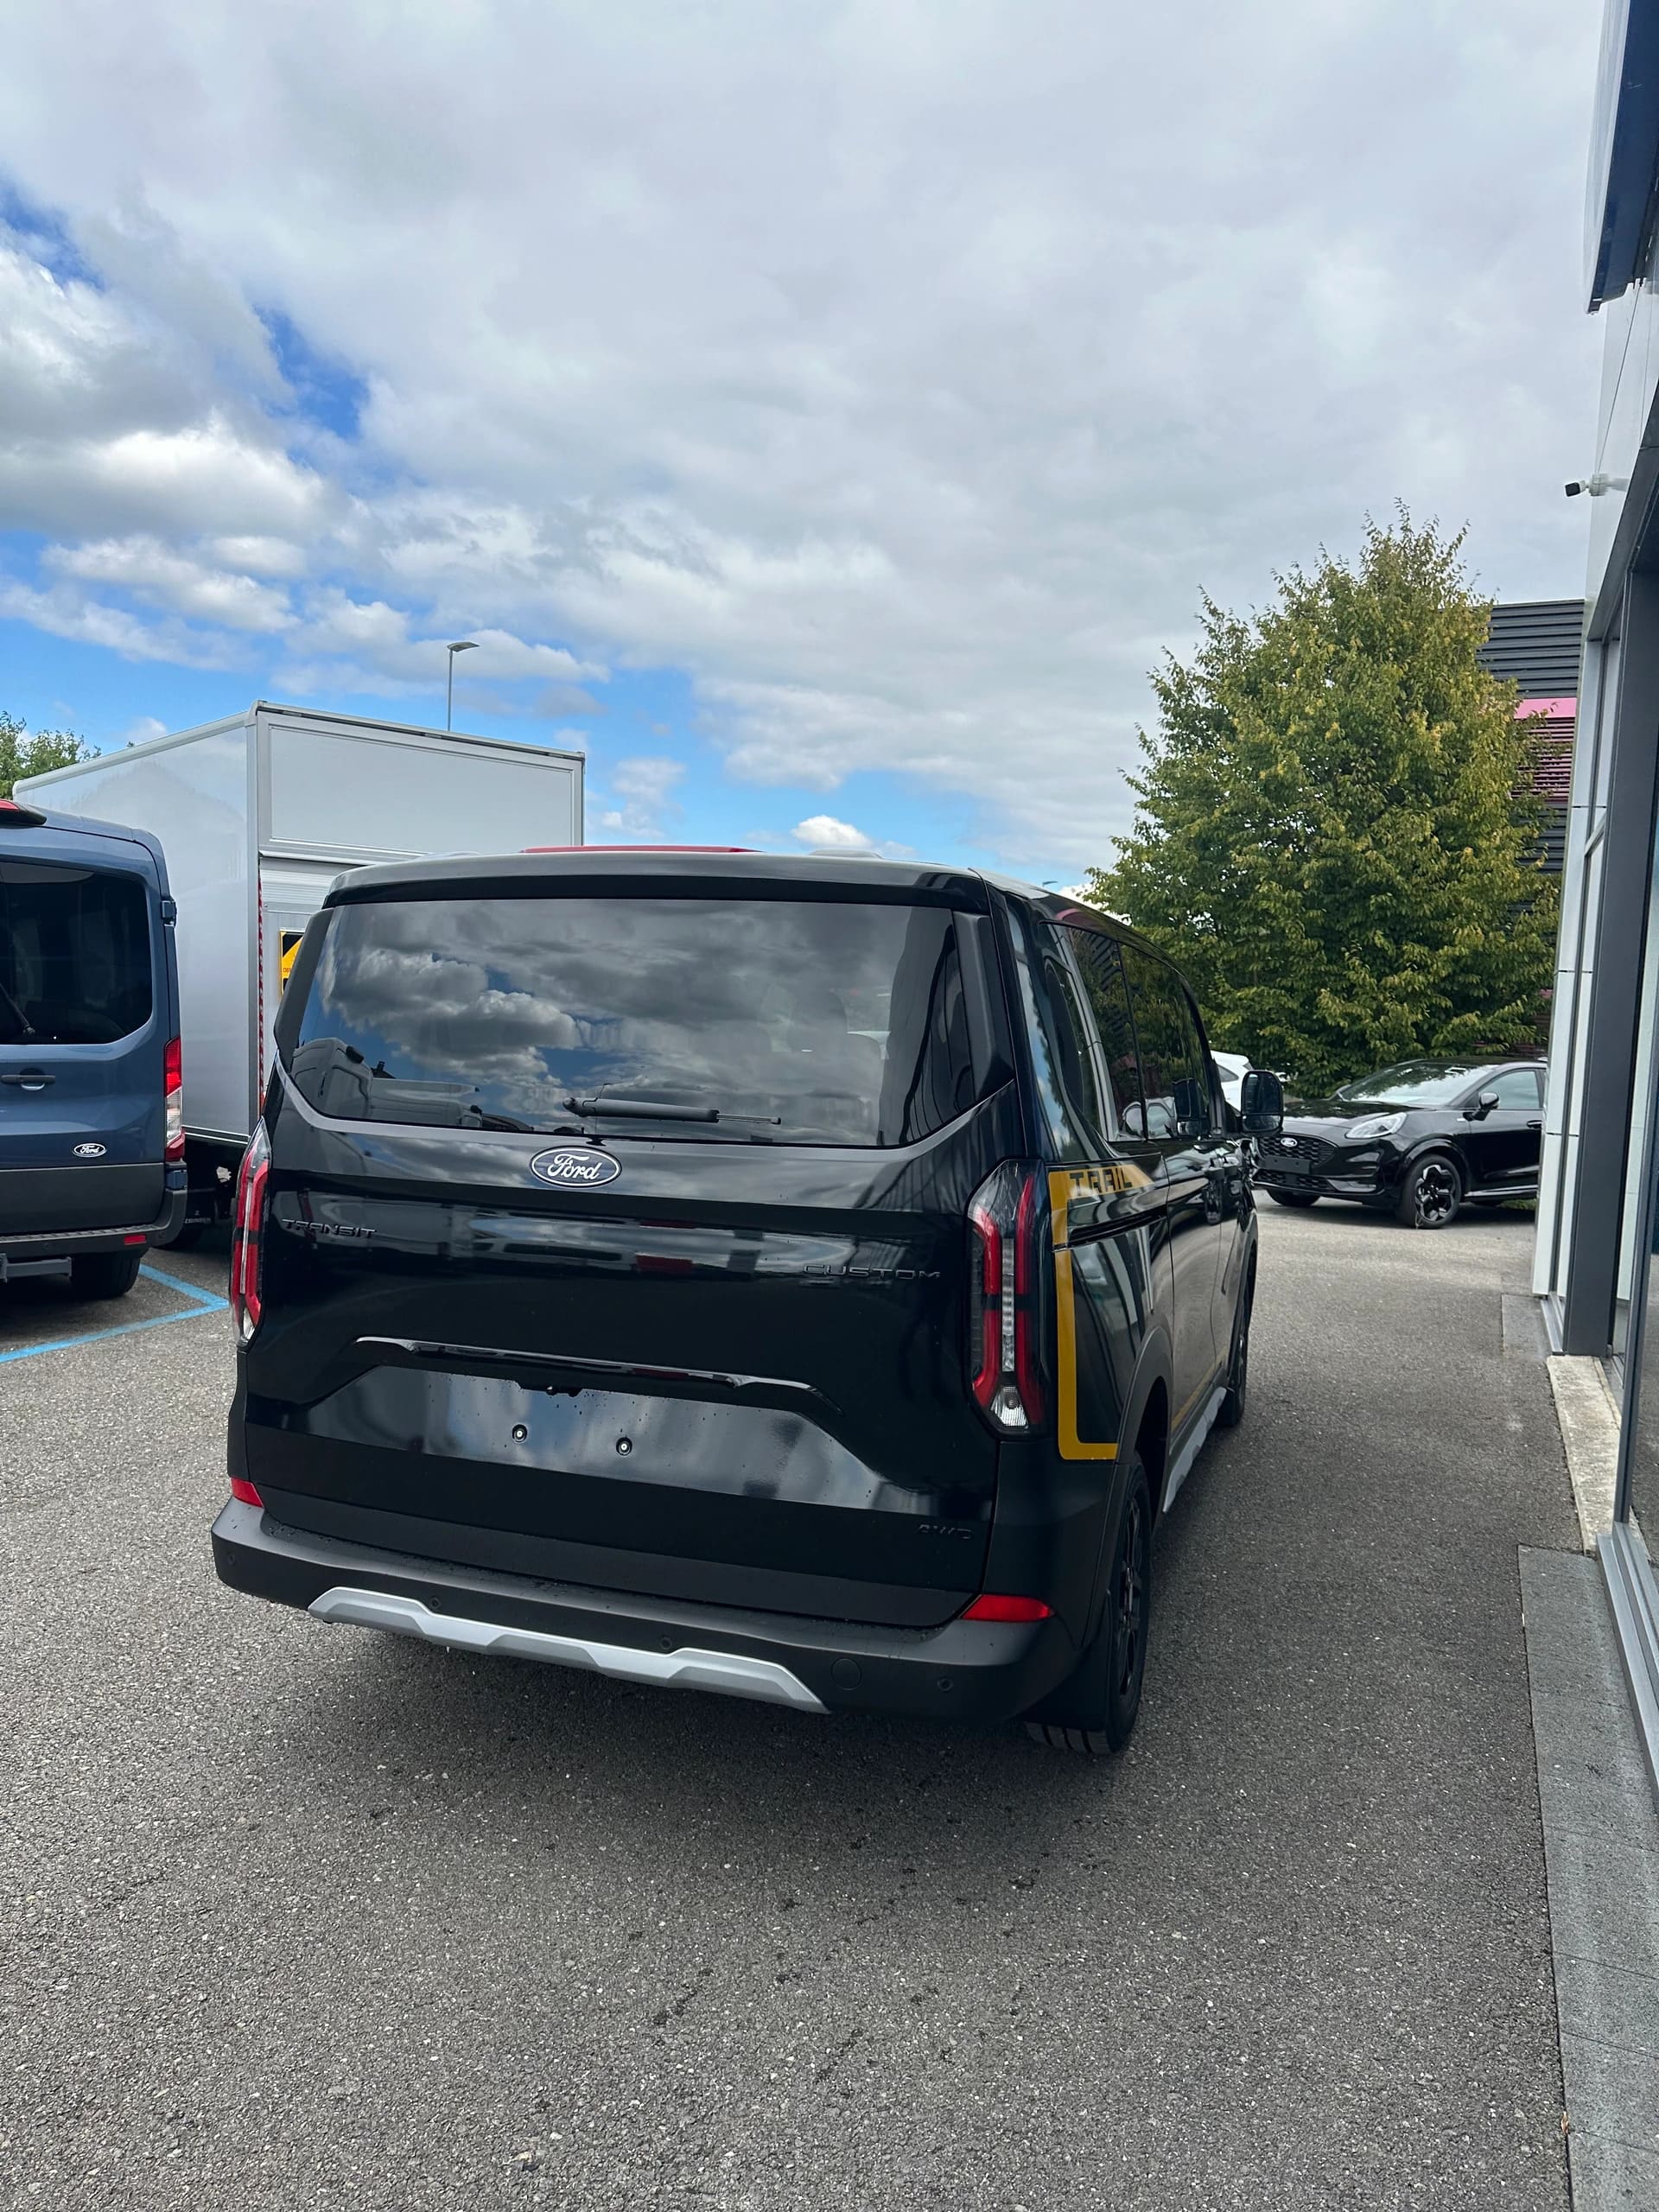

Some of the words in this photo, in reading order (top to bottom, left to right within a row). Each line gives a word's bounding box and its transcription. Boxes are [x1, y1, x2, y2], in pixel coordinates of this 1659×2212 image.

[547, 1153, 603, 1180] Ford
[1069, 1167, 1134, 1197] TRAIL
[282, 1218, 377, 1239] TRANSIT
[804, 1264, 941, 1280] CUSTOM
